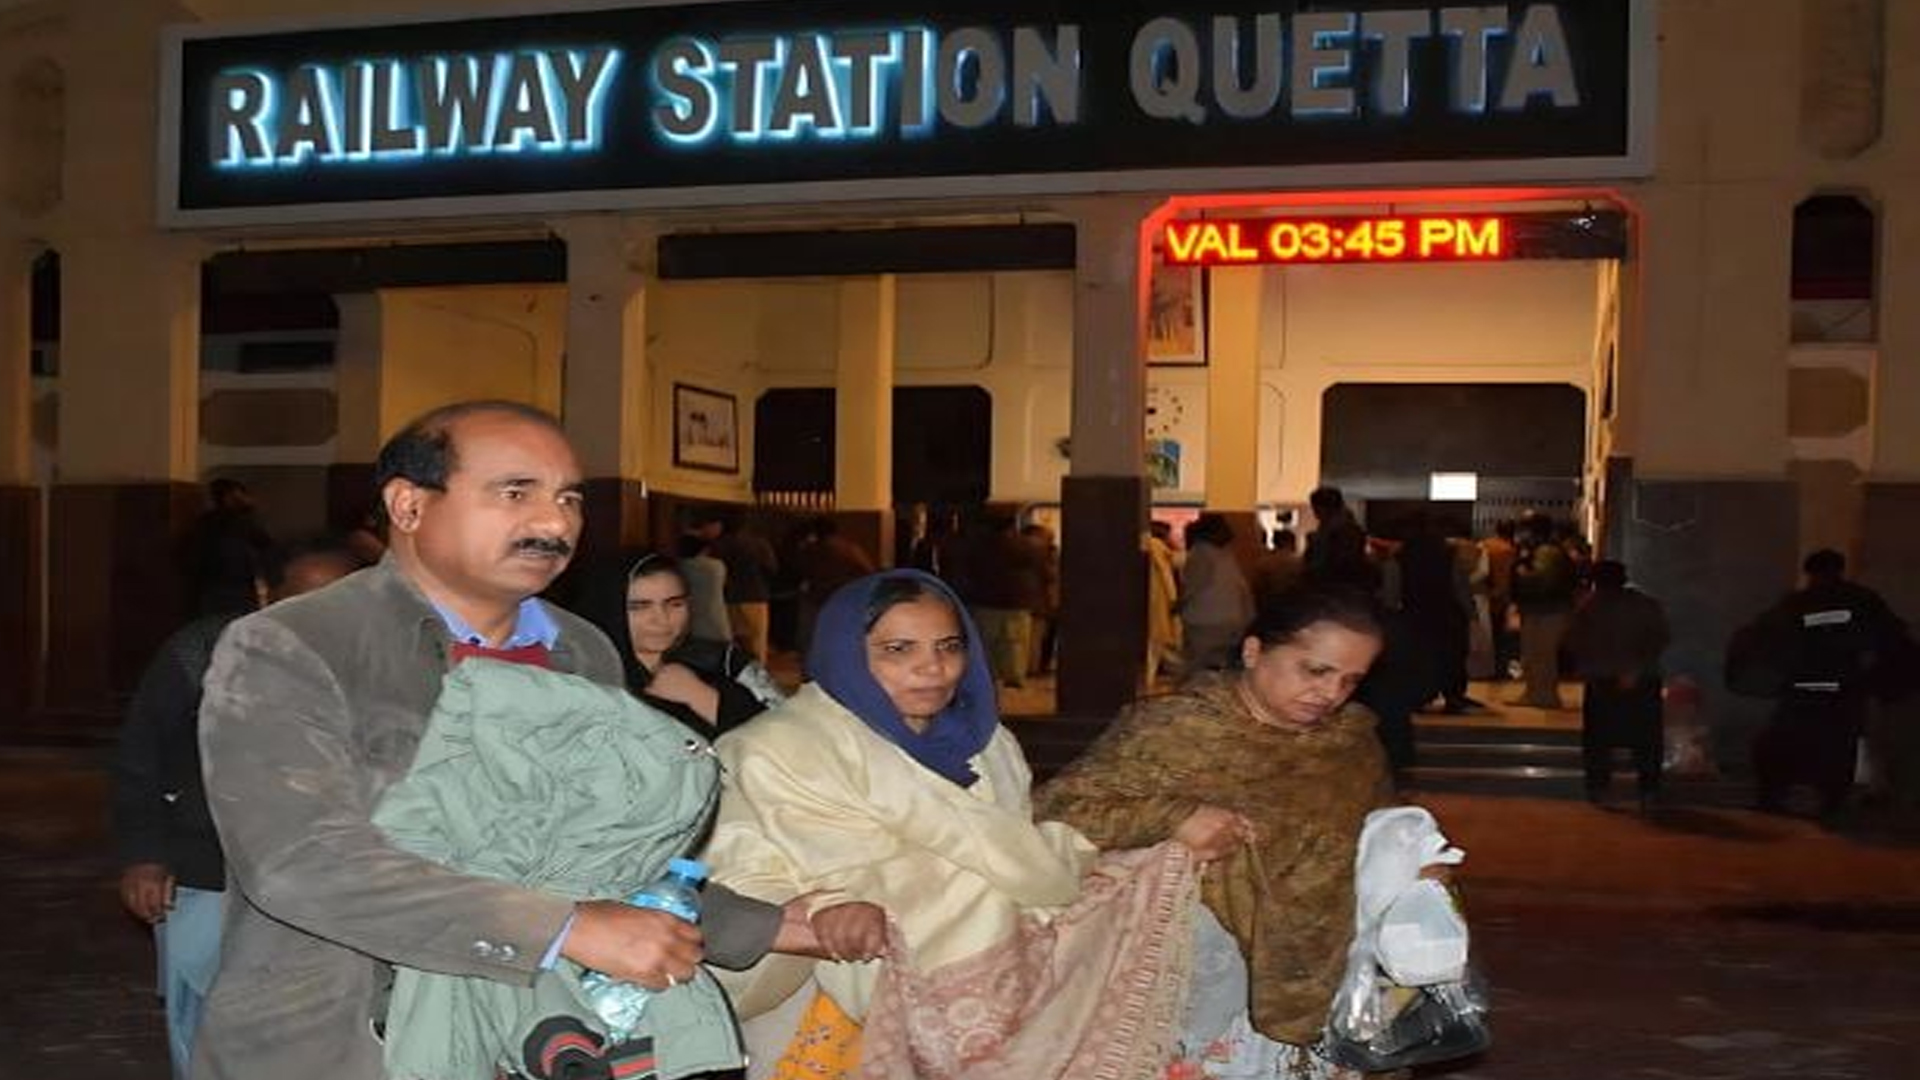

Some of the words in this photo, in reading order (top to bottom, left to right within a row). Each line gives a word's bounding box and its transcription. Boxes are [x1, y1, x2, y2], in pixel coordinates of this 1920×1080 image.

[211, 49, 618, 167] RAILWAY
[652, 25, 1082, 144] STATION
[1129, 4, 1580, 124] QUETTA
[1166, 226, 1258, 261] VAL
[1270, 221, 1405, 260] 03:45
[1421, 218, 1500, 257] PM
